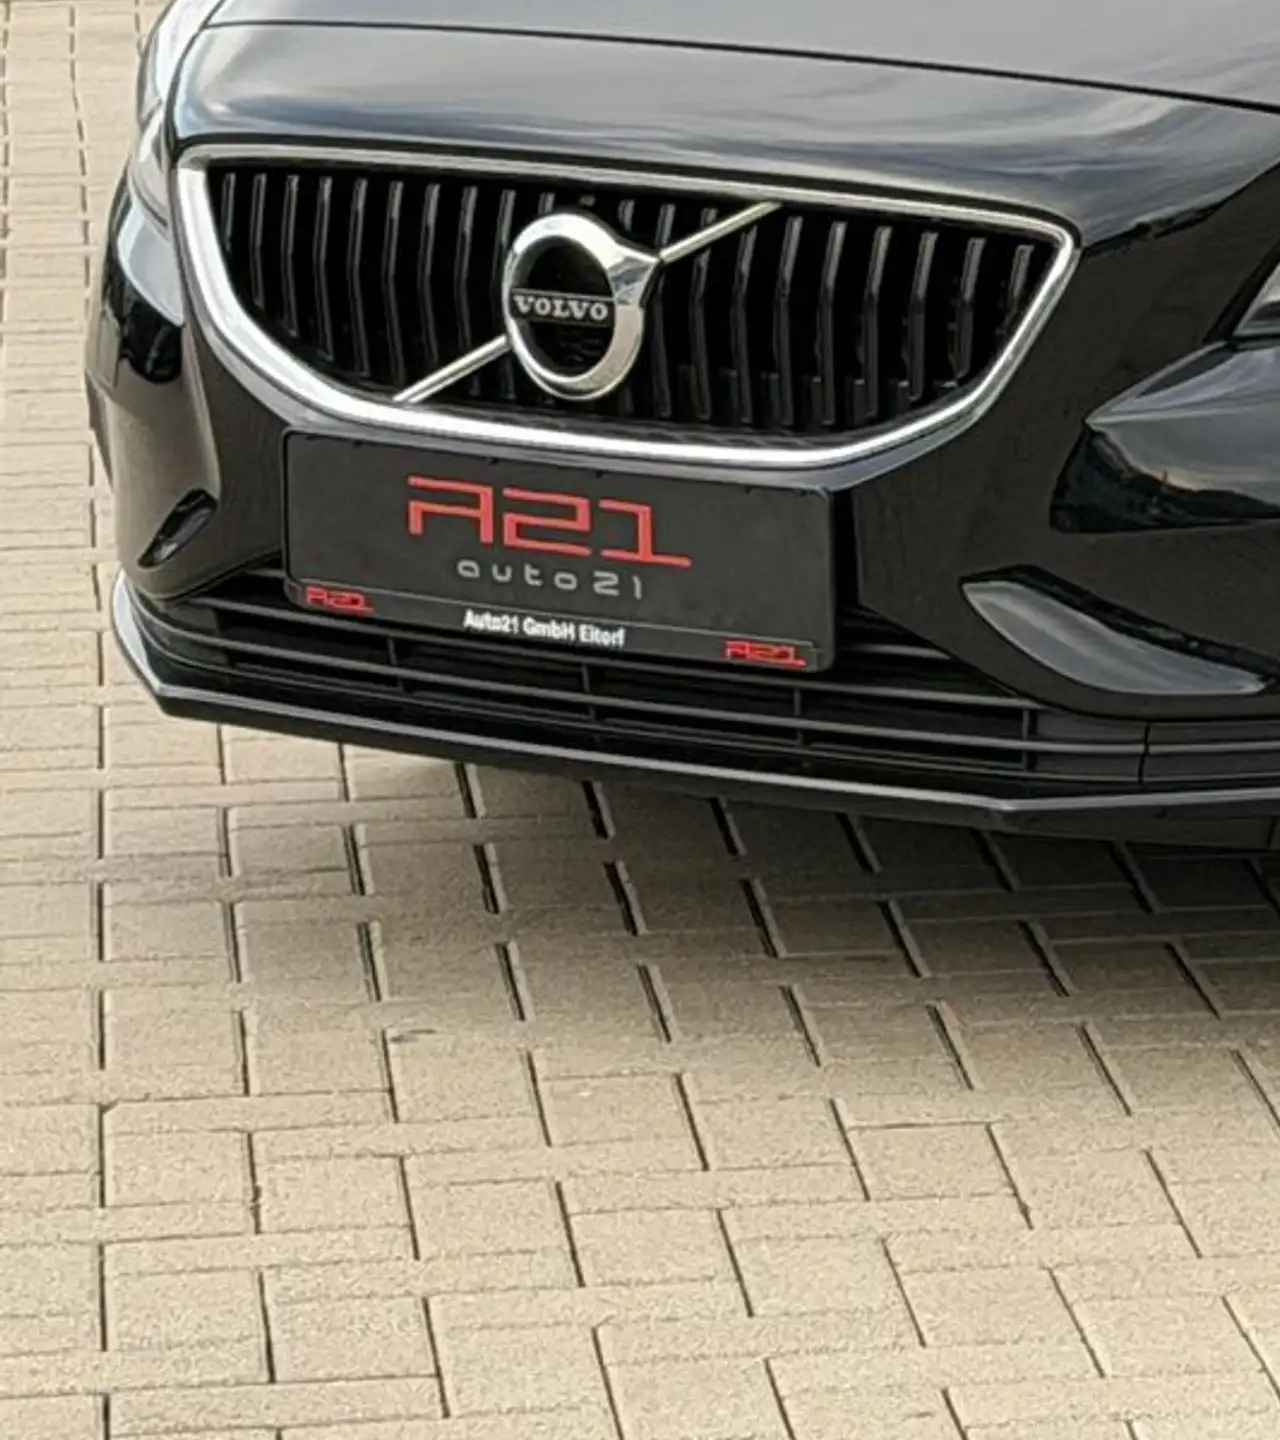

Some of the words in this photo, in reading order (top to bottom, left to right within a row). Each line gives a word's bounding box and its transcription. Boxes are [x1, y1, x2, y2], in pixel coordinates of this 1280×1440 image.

[513, 295, 609, 321] VOLVO
[407, 475, 692, 569] A21
[463, 609, 519, 635] Auto21
[523, 616, 576, 642] GmbH
